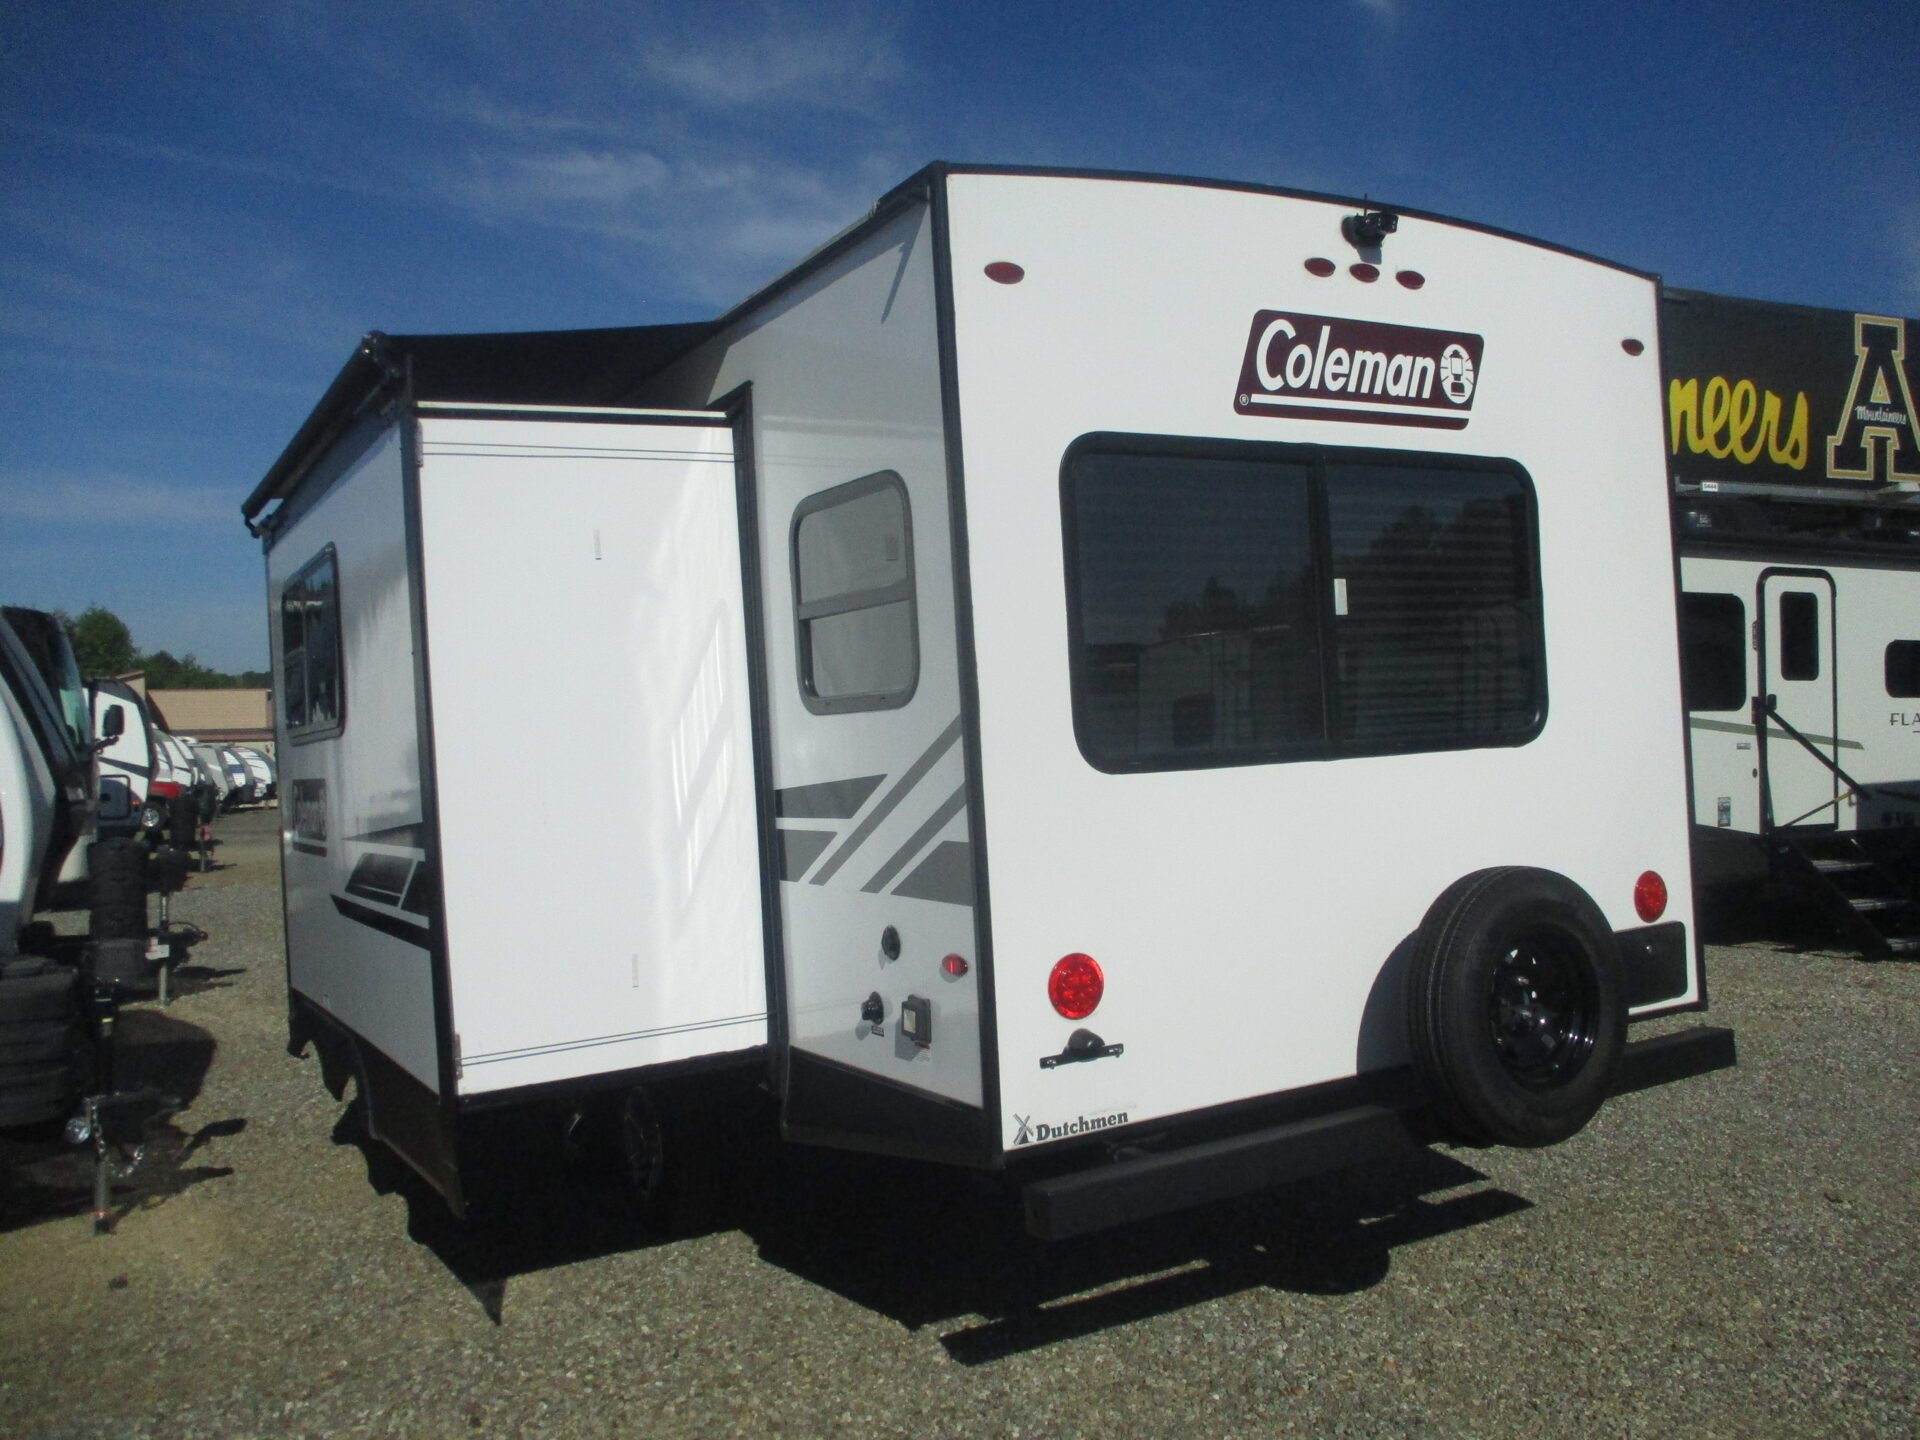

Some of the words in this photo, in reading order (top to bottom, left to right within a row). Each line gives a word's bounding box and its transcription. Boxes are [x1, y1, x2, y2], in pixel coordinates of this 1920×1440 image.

[1256, 318, 1436, 399] Coleman
[1827, 313, 1920, 481] A
[1036, 1112, 1128, 1142] Dutchmen
